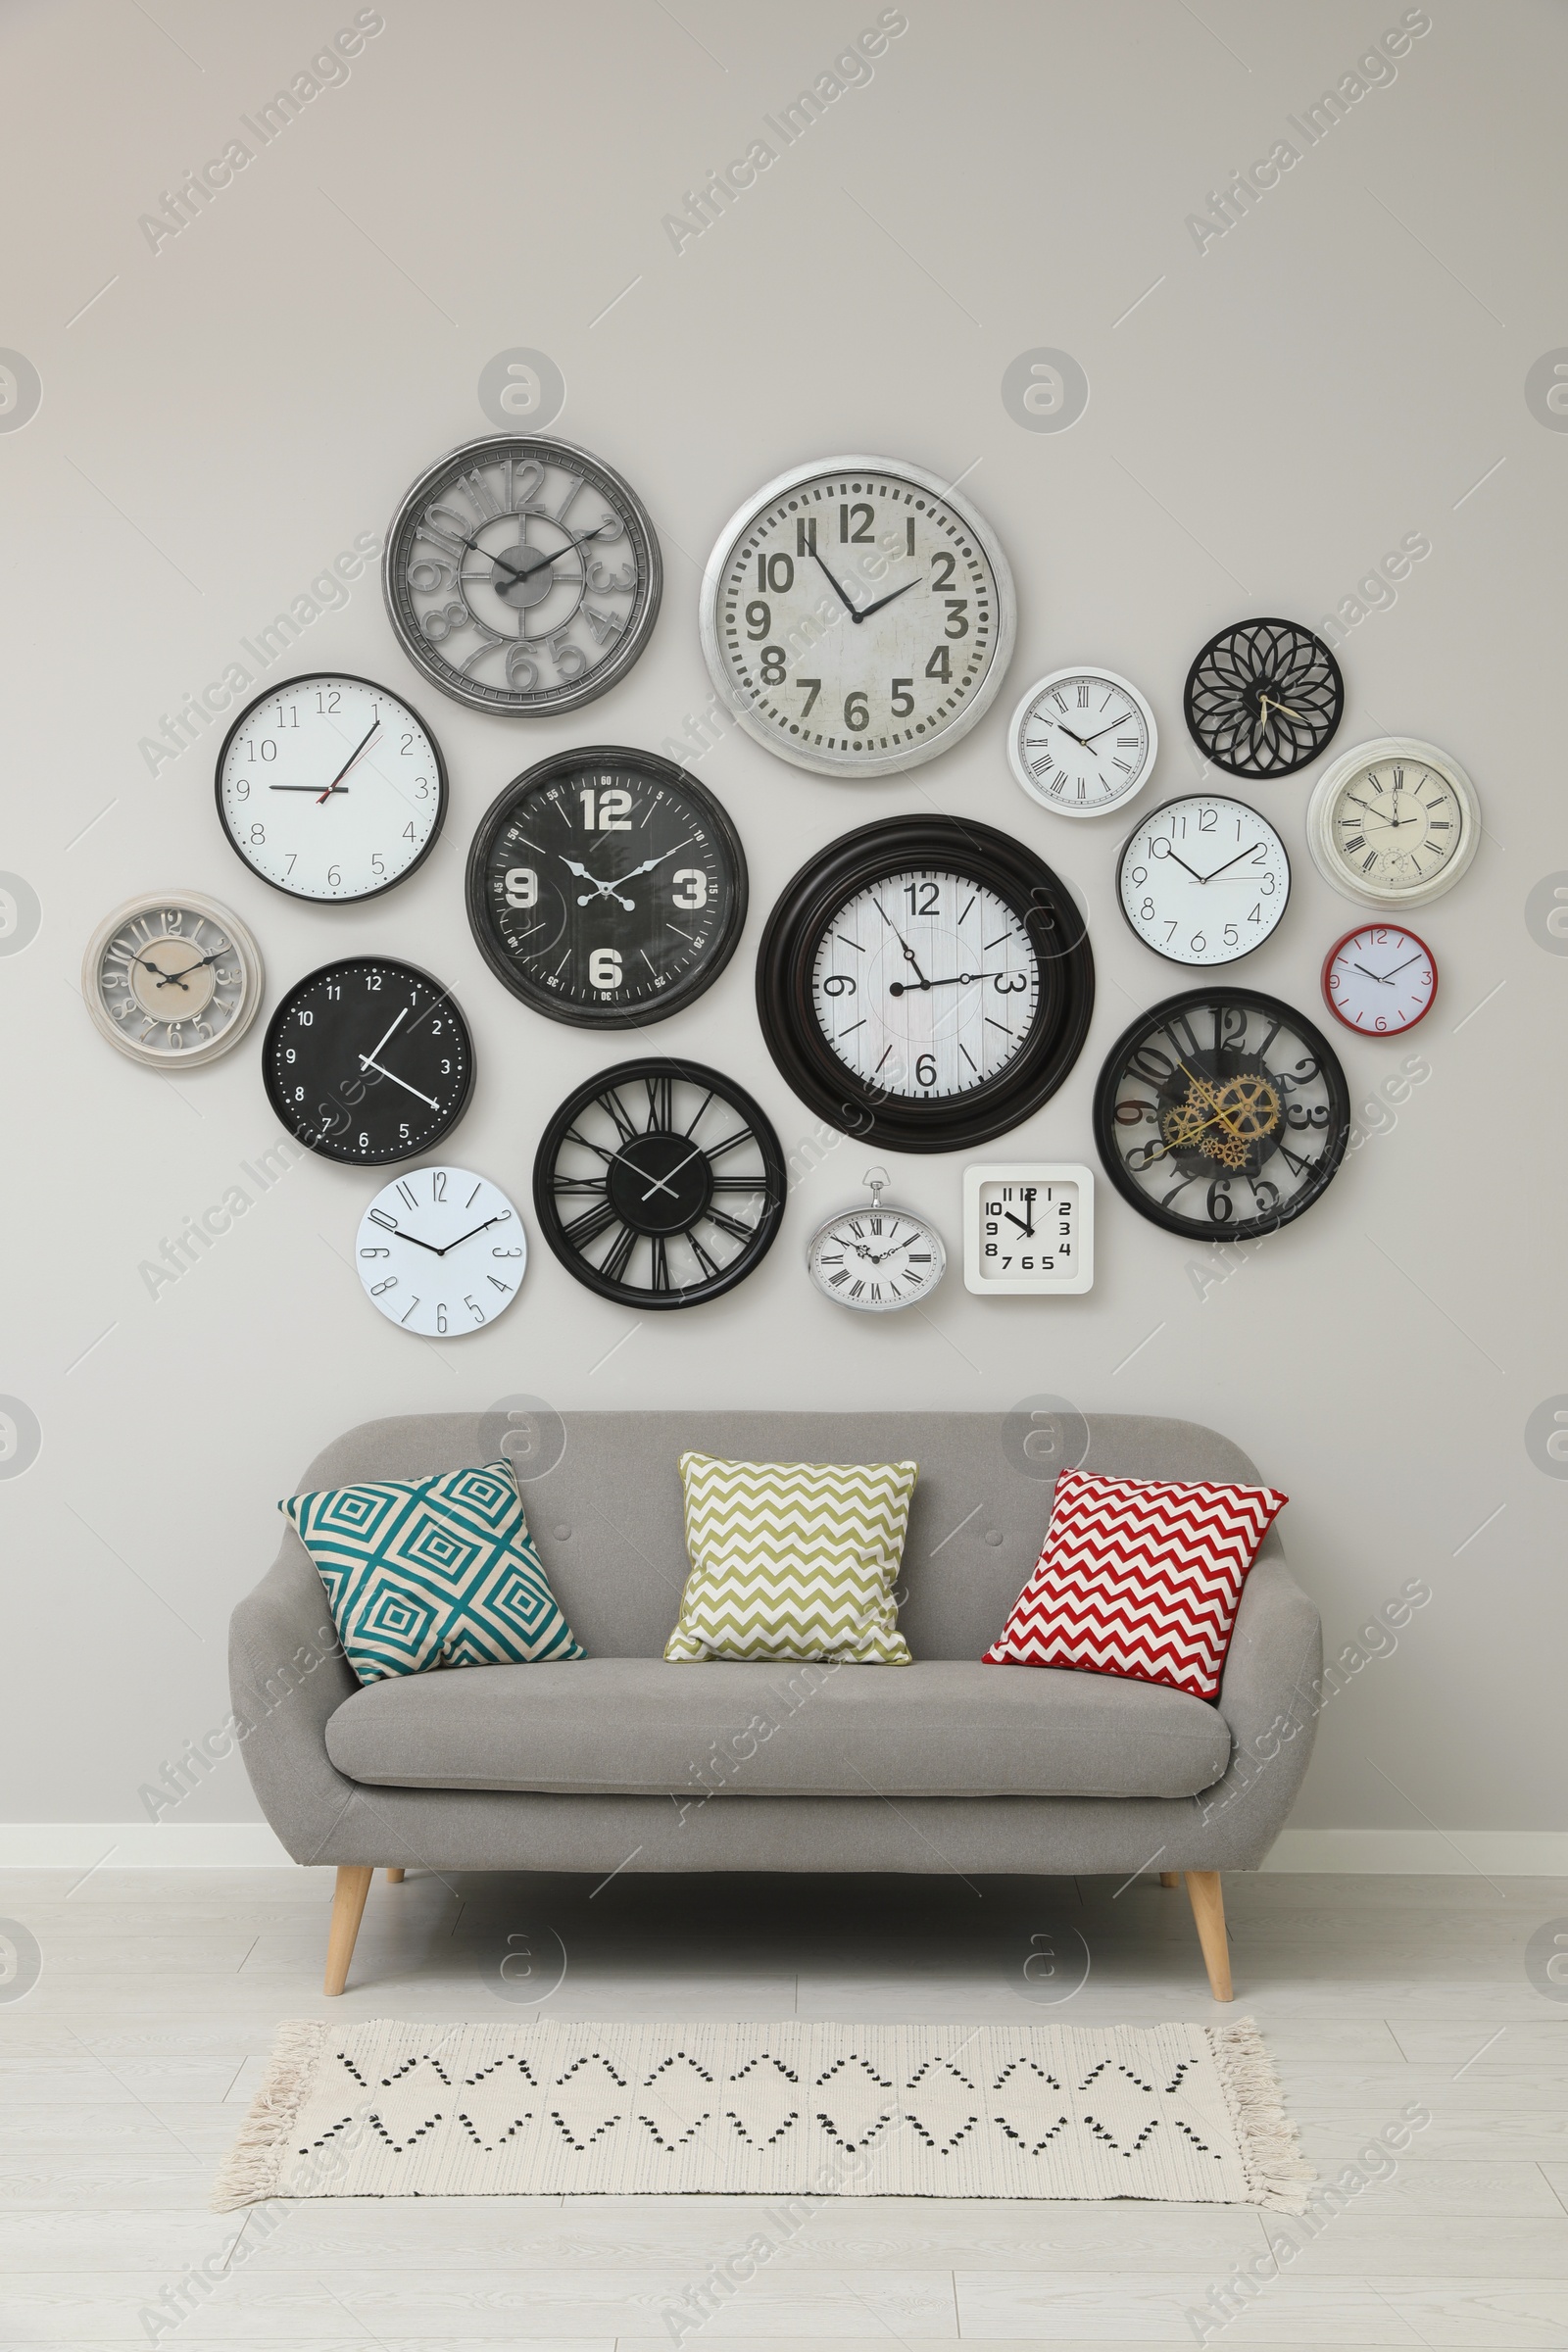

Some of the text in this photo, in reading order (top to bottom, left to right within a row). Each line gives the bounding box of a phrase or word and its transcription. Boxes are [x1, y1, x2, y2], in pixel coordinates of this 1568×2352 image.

[457, 468, 503, 523] 11
[500, 460, 545, 513] 12
[555, 476, 584, 522] 1
[416, 504, 473, 559] 10
[839, 503, 875, 543] 12
[797, 517, 816, 557] 11
[906, 517, 915, 556] 1
[408, 558, 458, 592] 9
[587, 561, 636, 594] 3
[758, 553, 795, 594] 10
[931, 552, 956, 592] 2
[419, 601, 468, 641] 8
[580, 601, 624, 645] 4
[746, 601, 771, 641] 9
[944, 599, 968, 640] 3
[458, 623, 503, 674] 7
[546, 626, 586, 681] 5
[506, 642, 538, 692] 6
[760, 646, 786, 686] 8
[925, 646, 953, 684] 4
[316, 692, 341, 713] 12
[796, 679, 821, 717] 7
[891, 678, 914, 717] 5
[276, 706, 300, 727] 11
[371, 704, 381, 726] 1
[844, 691, 869, 731] 6
[246, 740, 277, 762] 10
[400, 734, 414, 756] 2
[236, 779, 250, 802] 9
[415, 777, 429, 800] 3
[601, 776, 612, 785] 60
[547, 789, 559, 801] 55
[656, 791, 664, 801] 5
[579, 789, 632, 830] 12
[1199, 808, 1217, 831] 12
[251, 823, 266, 845] 8
[402, 821, 416, 843] 4
[507, 828, 519, 840] 50
[693, 830, 705, 842] 10
[1171, 816, 1186, 839] 11
[1237, 819, 1240, 842] 1
[1148, 837, 1171, 859] 10
[1251, 842, 1267, 864] 2
[285, 854, 297, 875] 7
[371, 854, 385, 874] 5
[327, 865, 341, 887] 6
[1132, 866, 1148, 889] 9
[1260, 872, 1275, 895] 3
[494, 882, 503, 894] 45
[505, 867, 538, 908] 9
[672, 869, 707, 909] 3
[710, 883, 717, 894] 15
[904, 883, 940, 916] 12
[1141, 898, 1154, 920] 8
[157, 908, 182, 936] 12
[1248, 903, 1261, 924] 4
[693, 937, 705, 949] 20
[1164, 921, 1178, 943] 7
[1191, 931, 1205, 952] 6
[1223, 924, 1238, 946] 5
[1371, 929, 1388, 945] 12
[105, 939, 135, 970] 10
[216, 969, 242, 986] 3
[589, 948, 622, 989] 6
[1421, 971, 1432, 985] 3
[102, 972, 128, 988] 9
[366, 976, 381, 991] 12
[655, 976, 665, 988] 25
[823, 975, 856, 998] 9
[994, 973, 1027, 995] 3
[1330, 975, 1340, 989] 9
[326, 986, 340, 1001] 11
[410, 992, 416, 1005] 1
[601, 992, 612, 1001] 30
[111, 998, 136, 1020] 8
[298, 1010, 313, 1026] 10
[432, 1020, 441, 1034] 2
[1208, 1005, 1248, 1053] 12
[1375, 1016, 1387, 1031] 6
[167, 1022, 183, 1050] 6
[1157, 1015, 1200, 1060] 11
[1249, 1019, 1283, 1059] 1
[286, 1049, 296, 1063] 9
[441, 1059, 450, 1074] 3
[915, 1054, 937, 1087] 6
[1123, 1046, 1175, 1099] 10
[1275, 1057, 1320, 1094] 2
[295, 1087, 304, 1101] 8
[1113, 1100, 1159, 1126] 9
[1287, 1103, 1330, 1130] 3
[322, 1118, 331, 1132] 7
[399, 1123, 409, 1138] 5
[359, 1132, 368, 1147] 6
[1125, 1139, 1169, 1172] 8
[433, 1172, 447, 1201] 12
[1004, 1188, 1011, 1201] 11
[1048, 1188, 1052, 1200] 1
[1246, 1175, 1279, 1211] 5
[986, 1202, 1002, 1215] 10
[1058, 1202, 1071, 1215] 2
[1206, 1179, 1233, 1223] 6
[368, 1208, 398, 1233] 10
[986, 1222, 998, 1235] 9
[1059, 1222, 1070, 1235] 3
[361, 1249, 390, 1257] 9
[492, 1248, 521, 1257] 3
[985, 1244, 998, 1256] 8
[1058, 1244, 1071, 1255] 4
[1003, 1256, 1012, 1269] 7
[1022, 1256, 1034, 1269] 6
[1042, 1256, 1054, 1269] 5
[370, 1276, 397, 1296] 8
[487, 1276, 514, 1292] 4
[402, 1296, 419, 1322] 7
[437, 1303, 447, 1333] 6
[464, 1295, 485, 1322] 5
